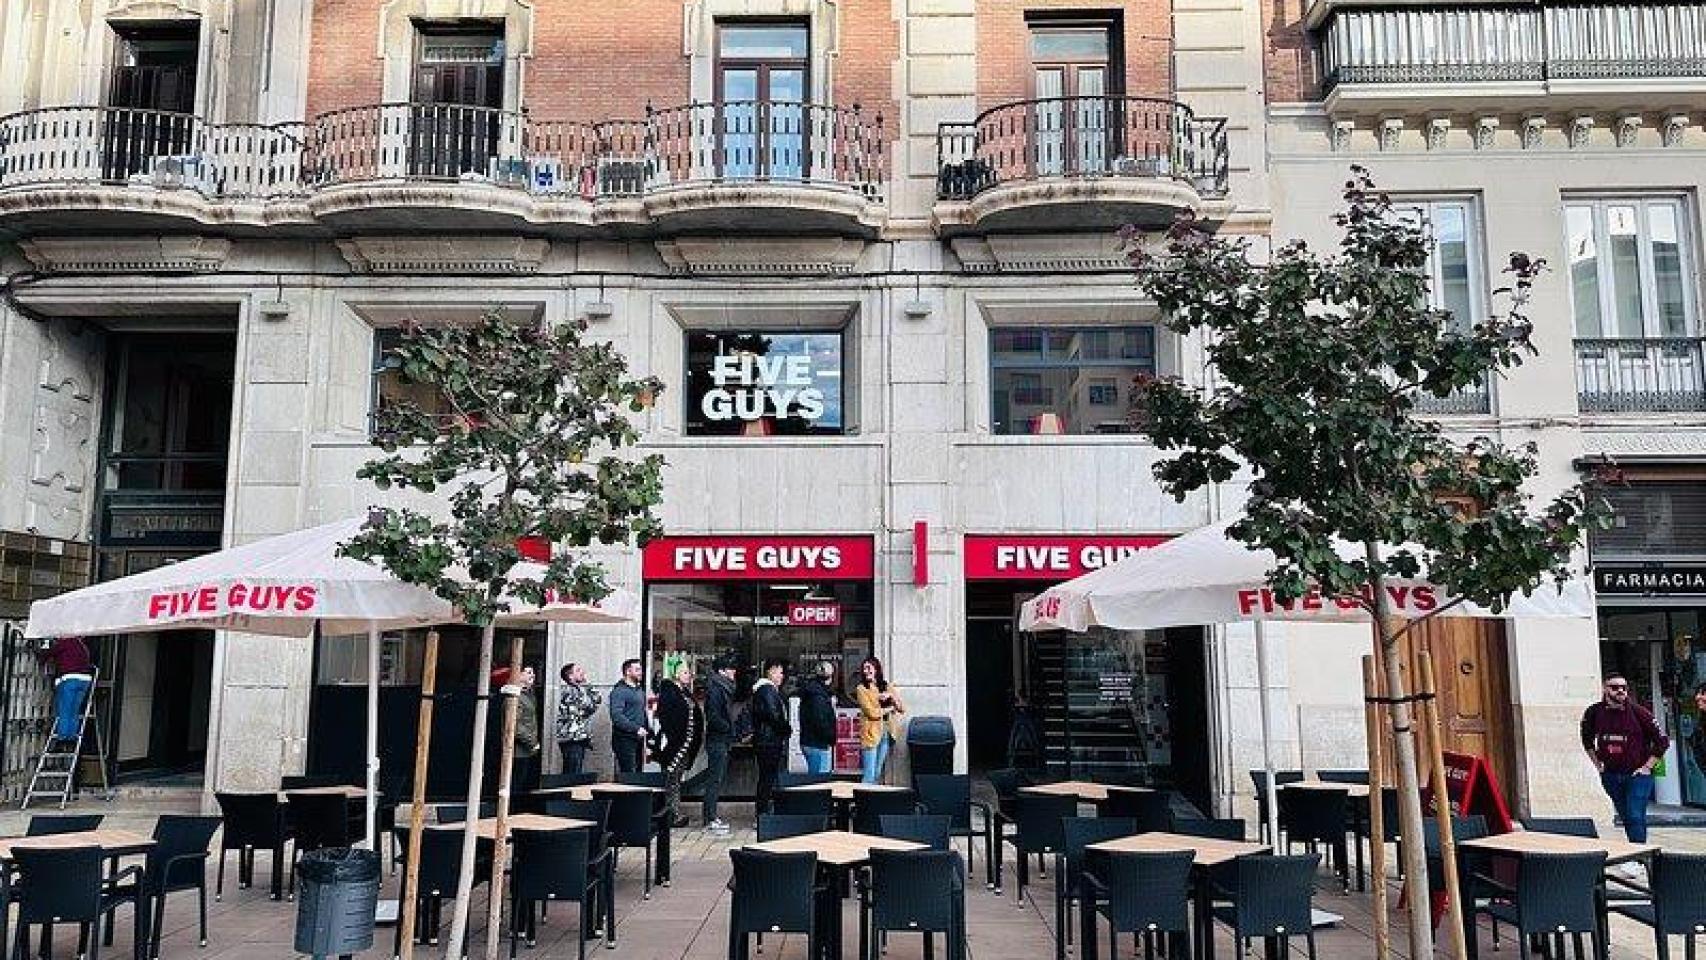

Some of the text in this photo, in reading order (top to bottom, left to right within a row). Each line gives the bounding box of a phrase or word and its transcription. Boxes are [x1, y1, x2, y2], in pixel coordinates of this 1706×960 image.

[713, 355, 812, 385] FIVE
[701, 387, 824, 420] GUYS
[674, 545, 842, 570] FIVE GUYS
[996, 545, 1148, 569] FIVE GU
[1603, 573, 1705, 587] FARMACIA
[148, 583, 316, 619] FIVE GUYS
[1334, 584, 1437, 611] YS
[793, 607, 837, 622] OPEN
